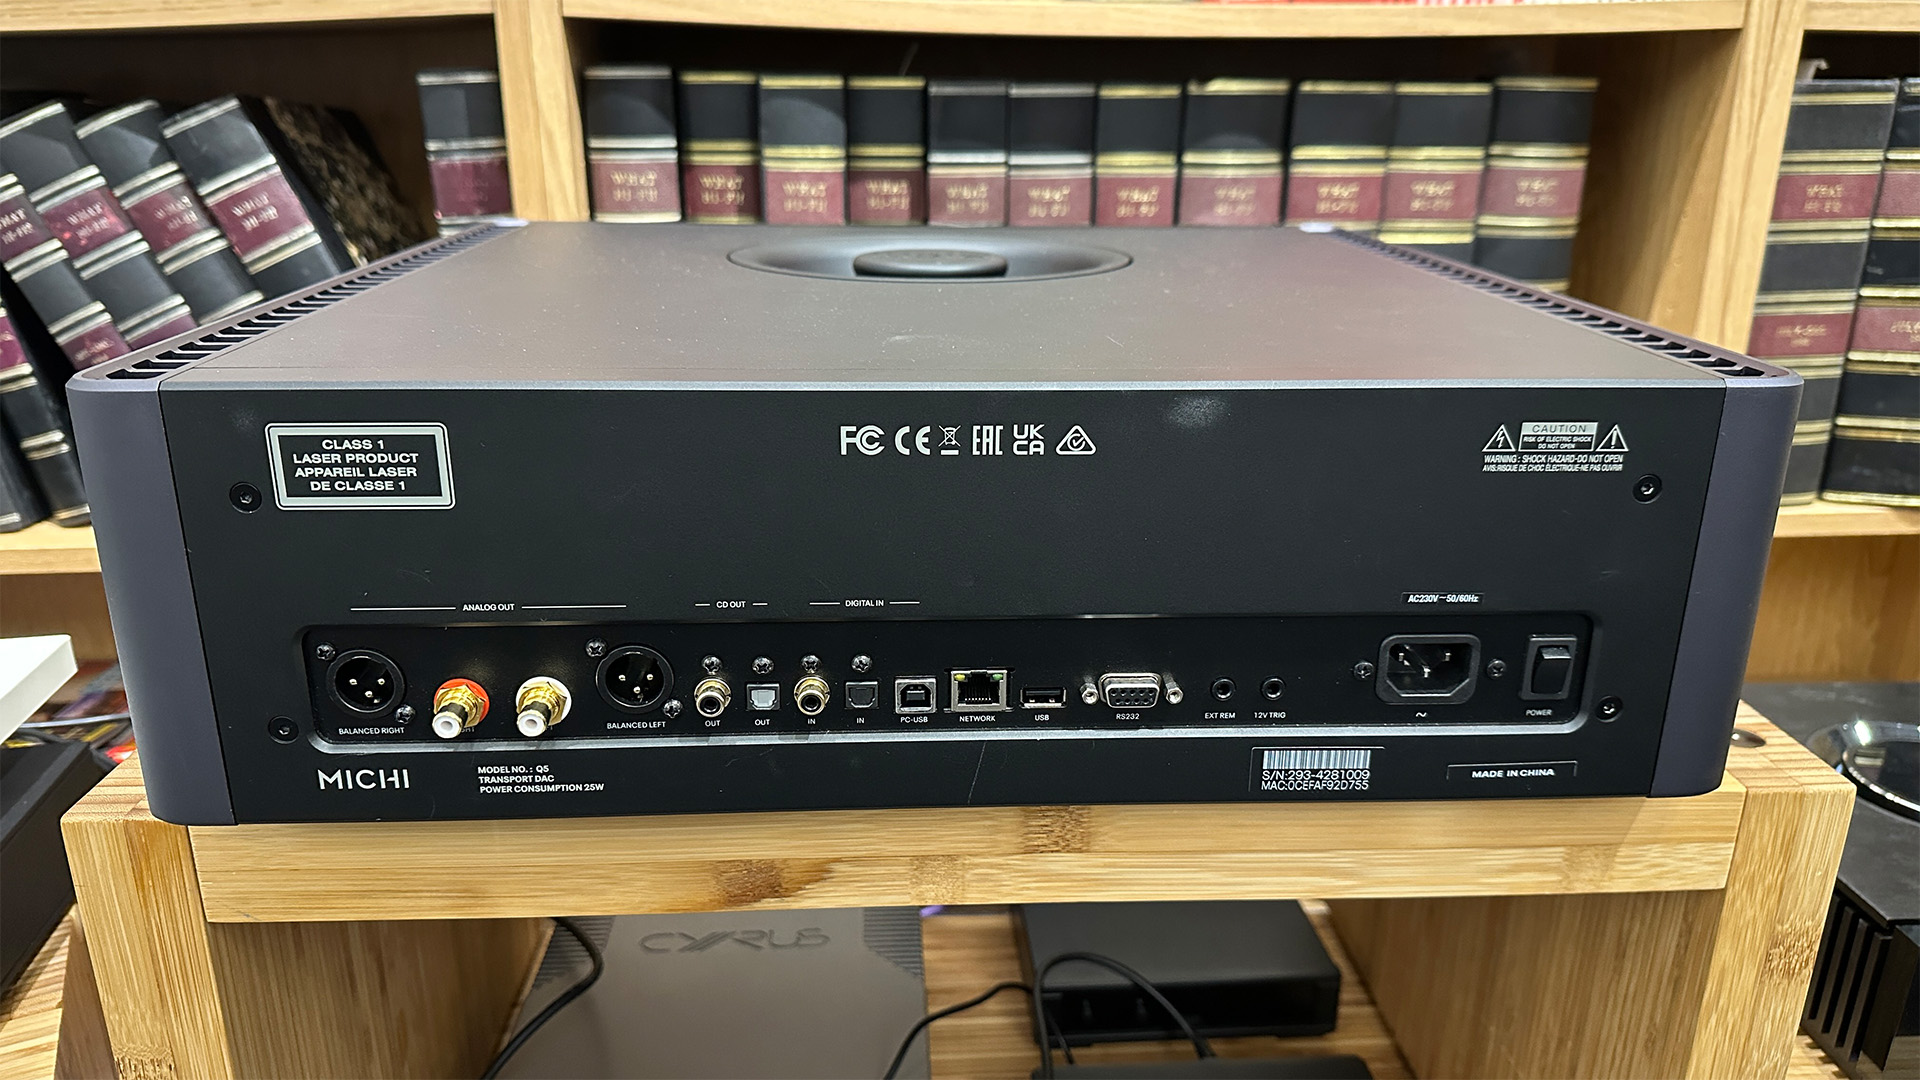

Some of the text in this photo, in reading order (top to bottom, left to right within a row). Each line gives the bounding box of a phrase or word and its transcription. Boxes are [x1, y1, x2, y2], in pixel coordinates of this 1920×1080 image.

[1013, 424, 1045, 439] UK
[1532, 424, 1587, 433] CAUTION
[321, 439, 384, 450] CLASS 1
[1013, 441, 1045, 455] CA
[292, 453, 419, 464] LASER PRODUCT
[1484, 454, 1517, 463] WARNING
[1522, 455, 1547, 463] SHOCK
[1547, 455, 1588, 463] HAZARD-DO
[1588, 454, 1604, 463] NOT
[1603, 454, 1624, 463] OPEN
[294, 467, 418, 477] APPAREIL LASER
[1518, 464, 1527, 472] DE
[1527, 464, 1545, 472] CHOC
[1589, 464, 1601, 472] PAS
[1601, 464, 1623, 472] OUVRIR
[310, 481, 406, 491] DE CLASSE 1
[462, 603, 515, 612] ANALOG OUT
[729, 600, 746, 608] OUT
[845, 600, 874, 608] DIGITAL
[1115, 712, 1140, 721] RS232
[1525, 708, 1553, 717] POWER
[754, 718, 771, 726] OUT
[856, 717, 865, 725] IN
[900, 716, 929, 724] PC-USB
[959, 715, 996, 723] NETWORK
[1034, 714, 1050, 722] USB
[606, 721, 647, 730] BALANCED
[704, 719, 721, 727] OUT
[338, 726, 405, 736] BALANCED RIGHT
[477, 766, 511, 774] MODEL
[535, 765, 549, 773] Q5
[1471, 767, 1555, 778] MADE IN CHINA
[317, 769, 410, 790] MICHI
[478, 775, 534, 784] TRANSPORT
[1261, 769, 1370, 781] S/N:293-4281009
[479, 783, 605, 793] POWER CONSUMPTION 25W
[638, 927, 831, 954] CYRUS
